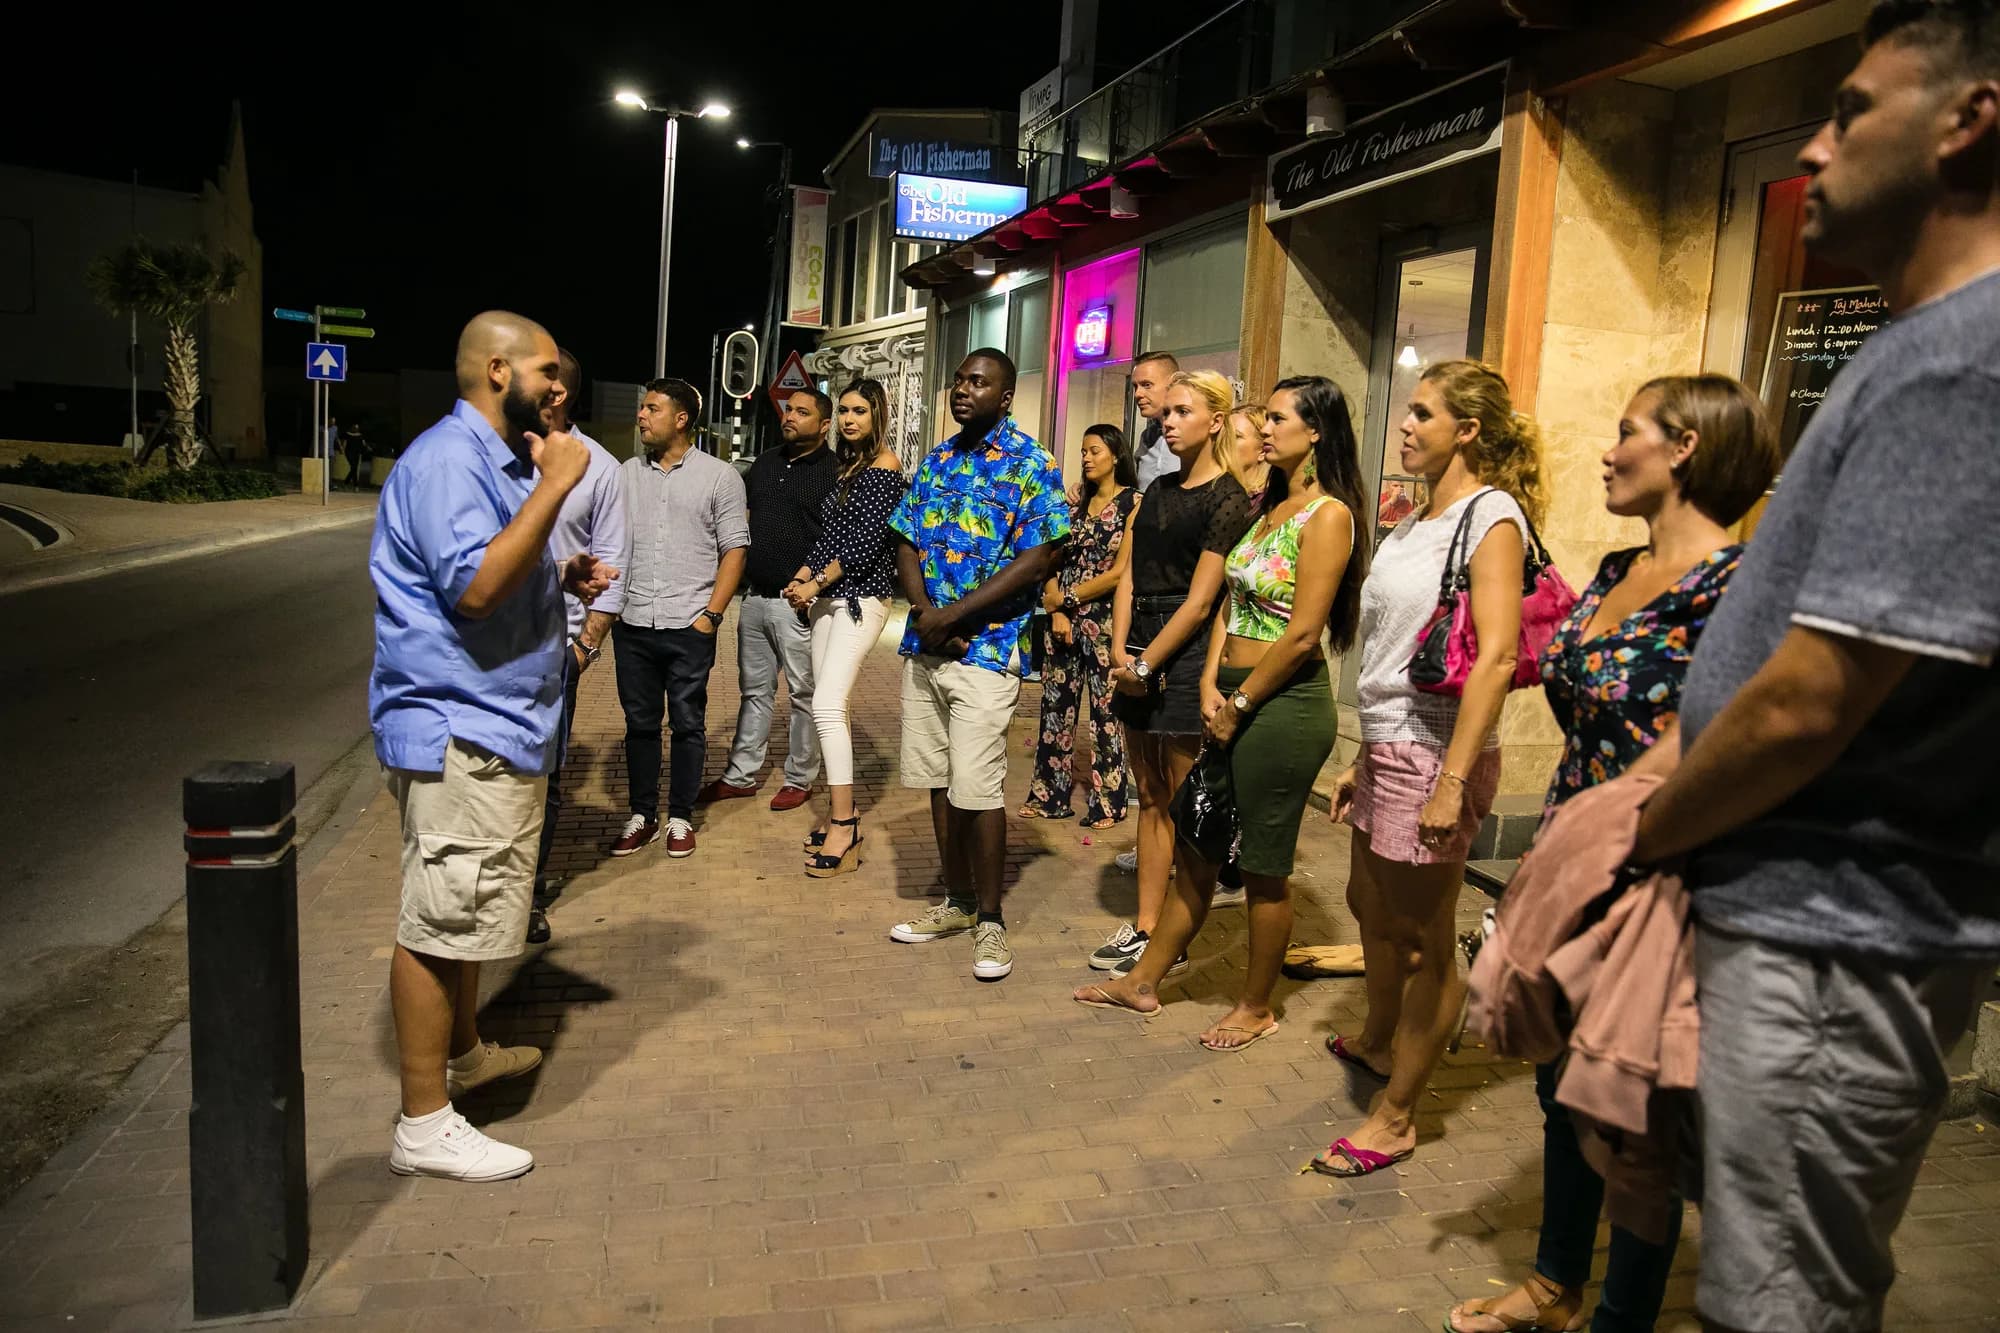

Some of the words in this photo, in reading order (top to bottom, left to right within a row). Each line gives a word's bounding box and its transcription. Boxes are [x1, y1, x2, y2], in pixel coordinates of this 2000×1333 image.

[879, 137, 898, 162] The
[901, 141, 923, 172] Old
[926, 141, 991, 173] Fisherman
[1286, 161, 1313, 193] The
[1321, 138, 1358, 180] Old
[1361, 106, 1485, 166] Fisherman
[899, 183, 926, 199] The
[926, 182, 968, 206] Old
[907, 197, 1013, 227] Fisherma
[895, 228, 916, 236] SEA
[921, 230, 951, 239] FOOD
[1833, 298, 1847, 314] Taj
[1849, 297, 1882, 310] Mahal
[1824, 325, 1852, 335] 12:00
[1853, 321, 1878, 333] Noon
[1800, 352, 1836, 370] Sunday
